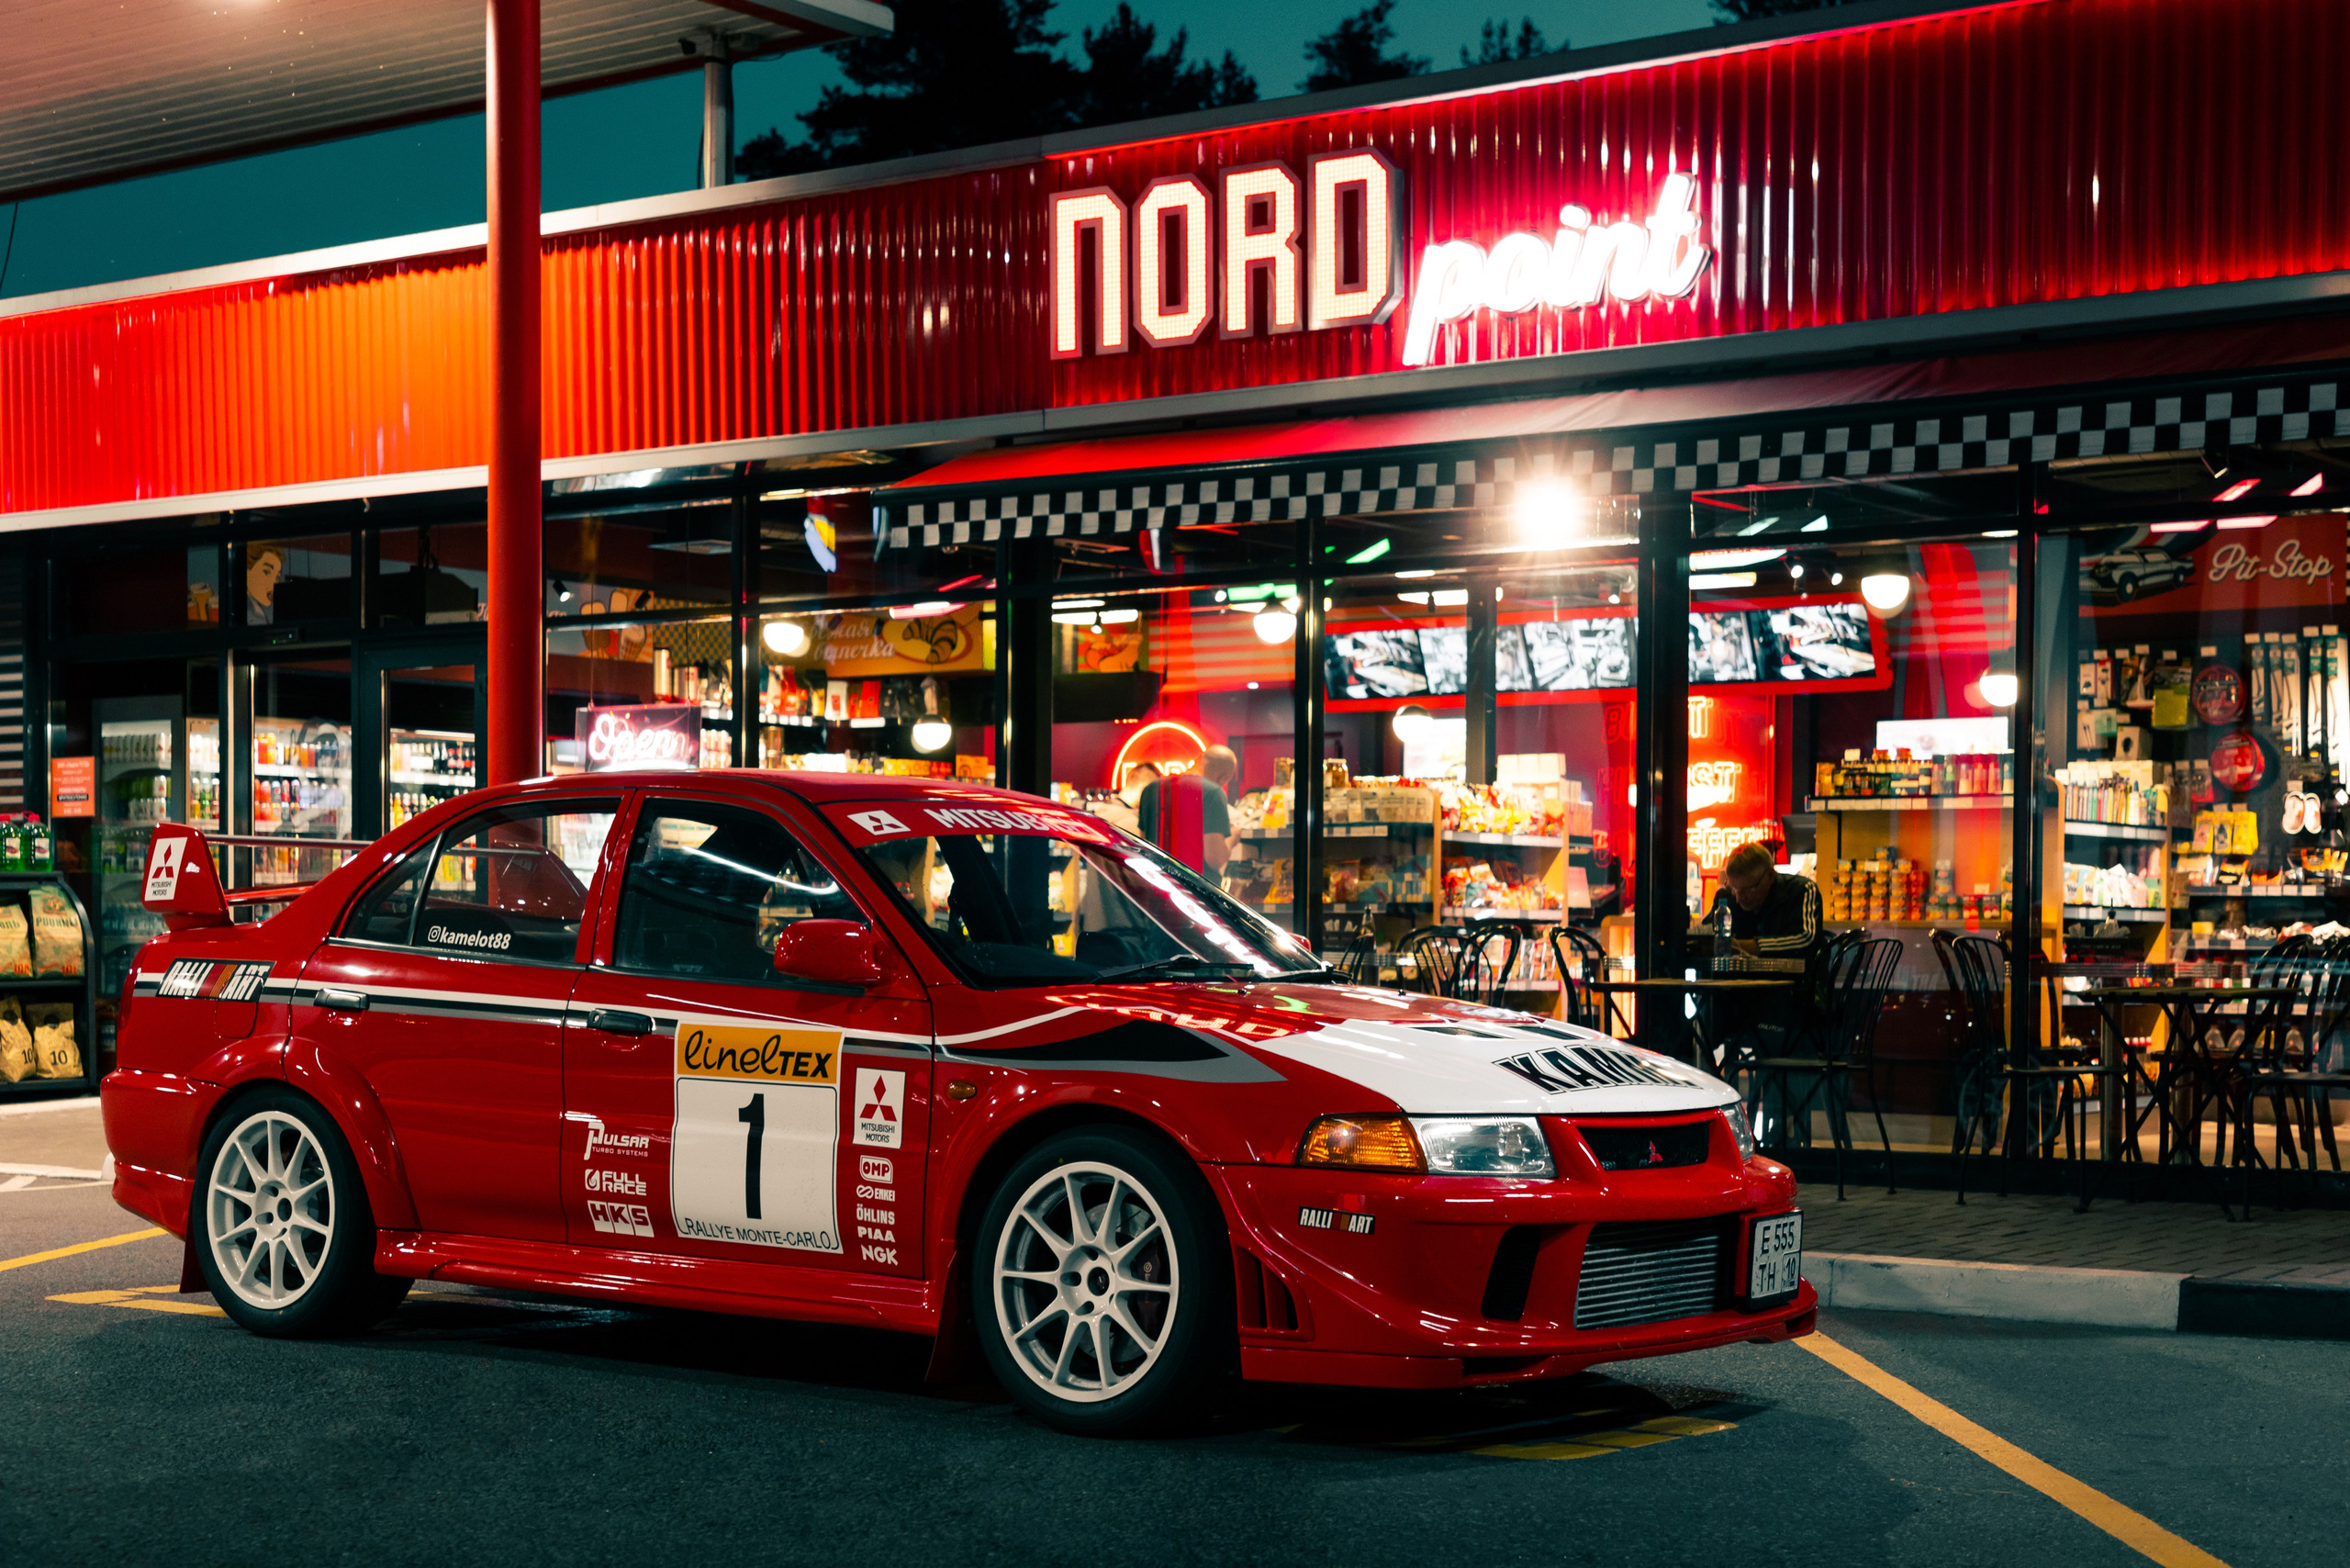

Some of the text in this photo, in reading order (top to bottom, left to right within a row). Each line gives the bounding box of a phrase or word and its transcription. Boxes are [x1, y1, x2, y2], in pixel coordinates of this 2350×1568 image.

[1052, 148, 1393, 356] NORD
[1402, 171, 1710, 365] point
[2209, 539, 2334, 586] Pit-Stop
[588, 713, 684, 765] Open
[151, 880, 173, 889] MITSUBISHI
[152, 889, 168, 897] MOTORS
[159, 960, 271, 1000] RALLI ART
[22, 1048, 33, 1064] 10
[50, 1050, 68, 1065] 10
[684, 1030, 833, 1078] linelTEX
[861, 1122, 895, 1134] MITSUBISHI
[866, 1133, 890, 1144] MOTORS
[584, 1122, 650, 1160] PULSAR
[592, 1146, 648, 1158] TURBO SYSTEMS
[738, 1092, 765, 1219] 1
[602, 1170, 646, 1185] FULL
[863, 1160, 890, 1177] OMP
[602, 1181, 647, 1196] RACE
[874, 1187, 896, 1202] ENKEI
[588, 1202, 652, 1230] HKS
[856, 1204, 896, 1226] ÖHLINS
[1300, 1208, 1373, 1234] RALLI ART
[684, 1217, 832, 1250] RALLYE MONTE-CARLO
[857, 1226, 896, 1243] PIAA
[1761, 1220, 1795, 1254] E 555
[860, 1244, 899, 1266] NGK
[1759, 1257, 1796, 1293] TH 10
